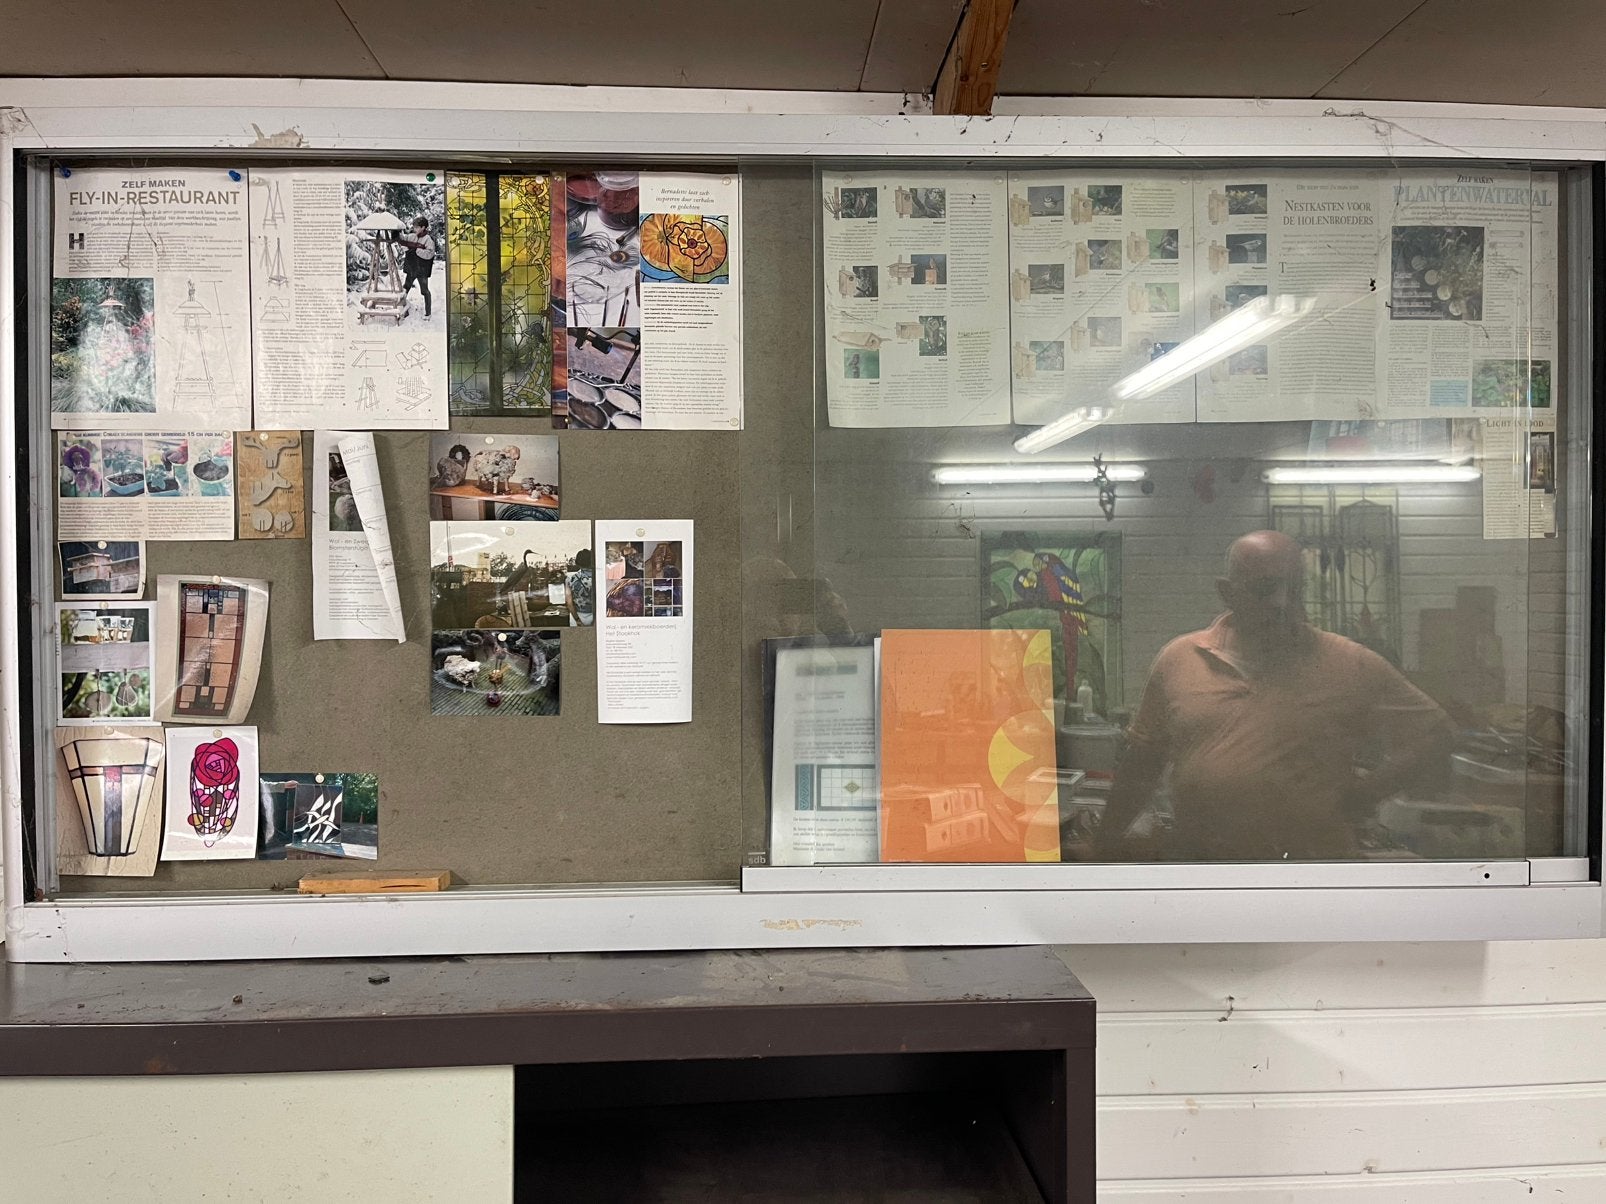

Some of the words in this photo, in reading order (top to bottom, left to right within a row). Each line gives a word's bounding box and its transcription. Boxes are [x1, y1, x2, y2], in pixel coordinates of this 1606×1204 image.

[121, 180, 146, 189] ZELF
[148, 180, 186, 188] MAKEN
[69, 190, 240, 206] FLY-IN-RESTAURANT
[1393, 185, 1552, 207] PLANTENWATERVAL
[1284, 200, 1344, 211] NESTKASTEN
[1346, 202, 1372, 211] VOOR
[1283, 216, 1296, 225] DE
[1297, 216, 1374, 226] HOLENBROEDERS
